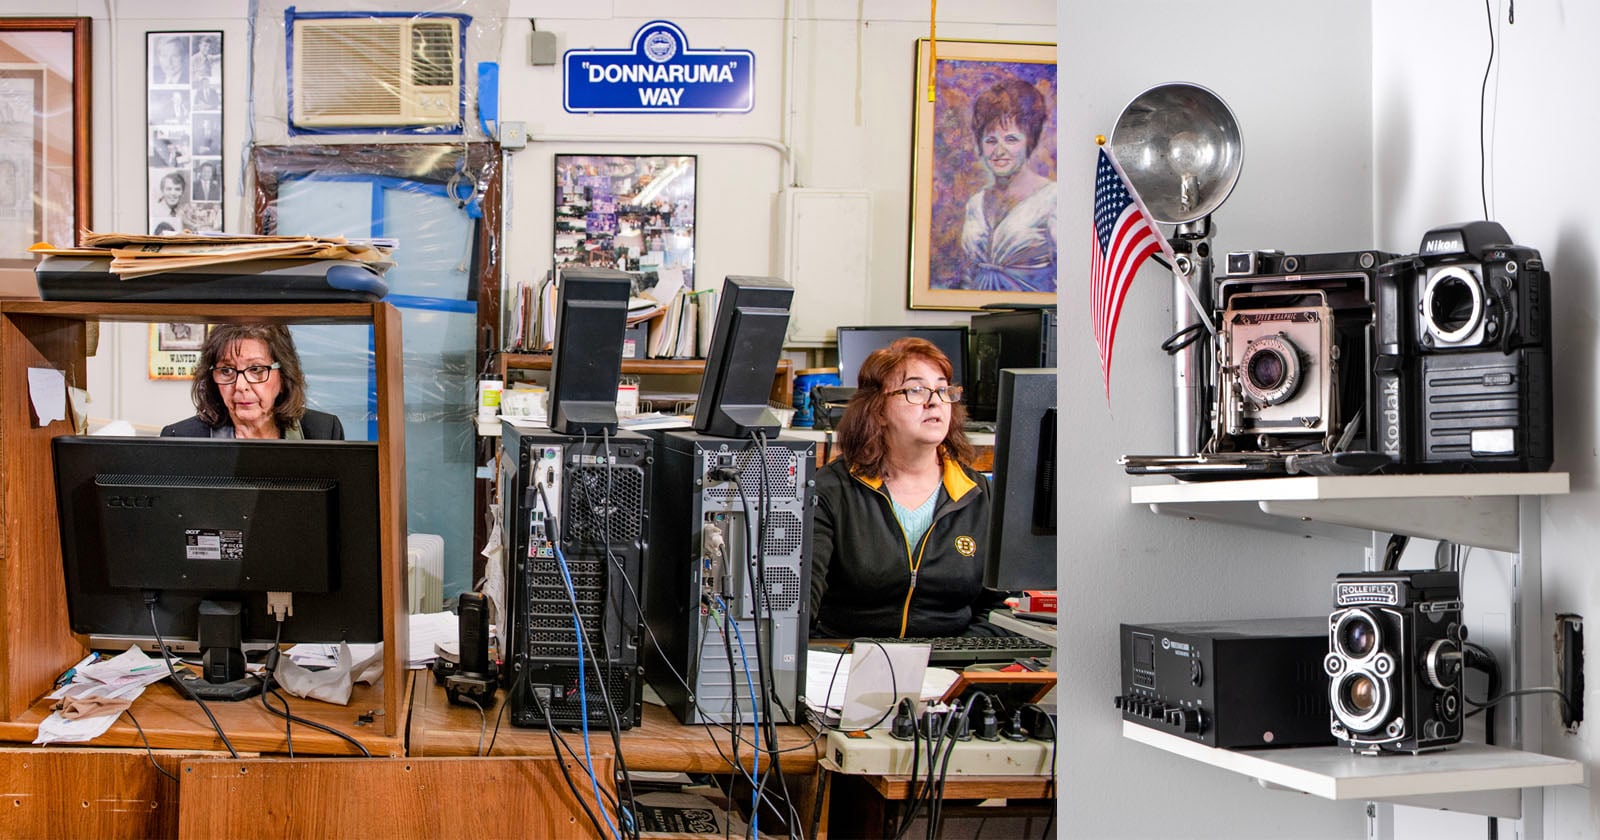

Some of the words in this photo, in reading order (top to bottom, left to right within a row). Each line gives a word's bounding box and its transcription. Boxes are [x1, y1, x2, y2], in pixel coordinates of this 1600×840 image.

[582, 62, 738, 83] "DONNARUMA"
[638, 88, 685, 106] WAY
[1425, 239, 1458, 253] Nikon
[169, 354, 196, 363] WANTED
[157, 366, 174, 376] DEAD
[178, 366, 187, 376] OR
[1384, 376, 1400, 456] Kodak
[1341, 585, 1393, 594] ROLLEIFLEX
